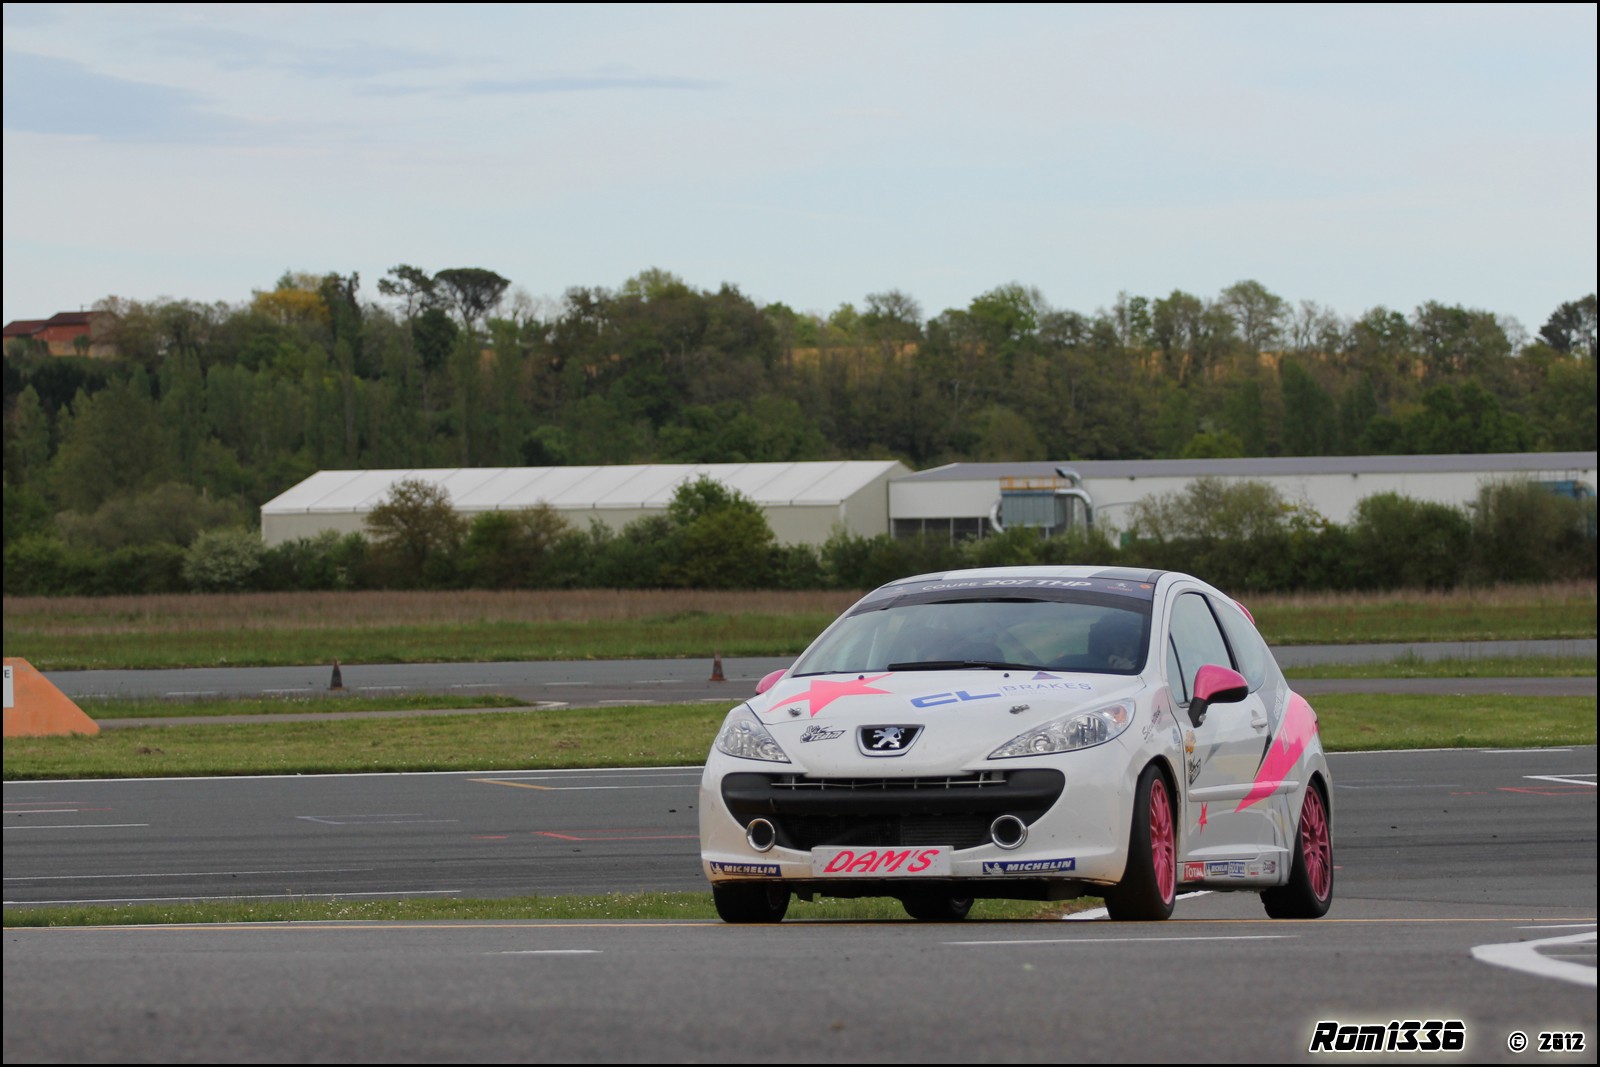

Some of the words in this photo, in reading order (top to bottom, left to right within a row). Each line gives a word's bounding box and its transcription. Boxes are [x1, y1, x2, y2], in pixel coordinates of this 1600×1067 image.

[922, 581, 978, 591] COUPE
[982, 579, 1033, 587] 207
[1002, 683, 1092, 692] BRAKES
[910, 690, 1002, 708] CL
[823, 849, 940, 873] DAM'S
[1006, 860, 1072, 871] MICHELIN
[723, 864, 777, 874] MICHELIN
